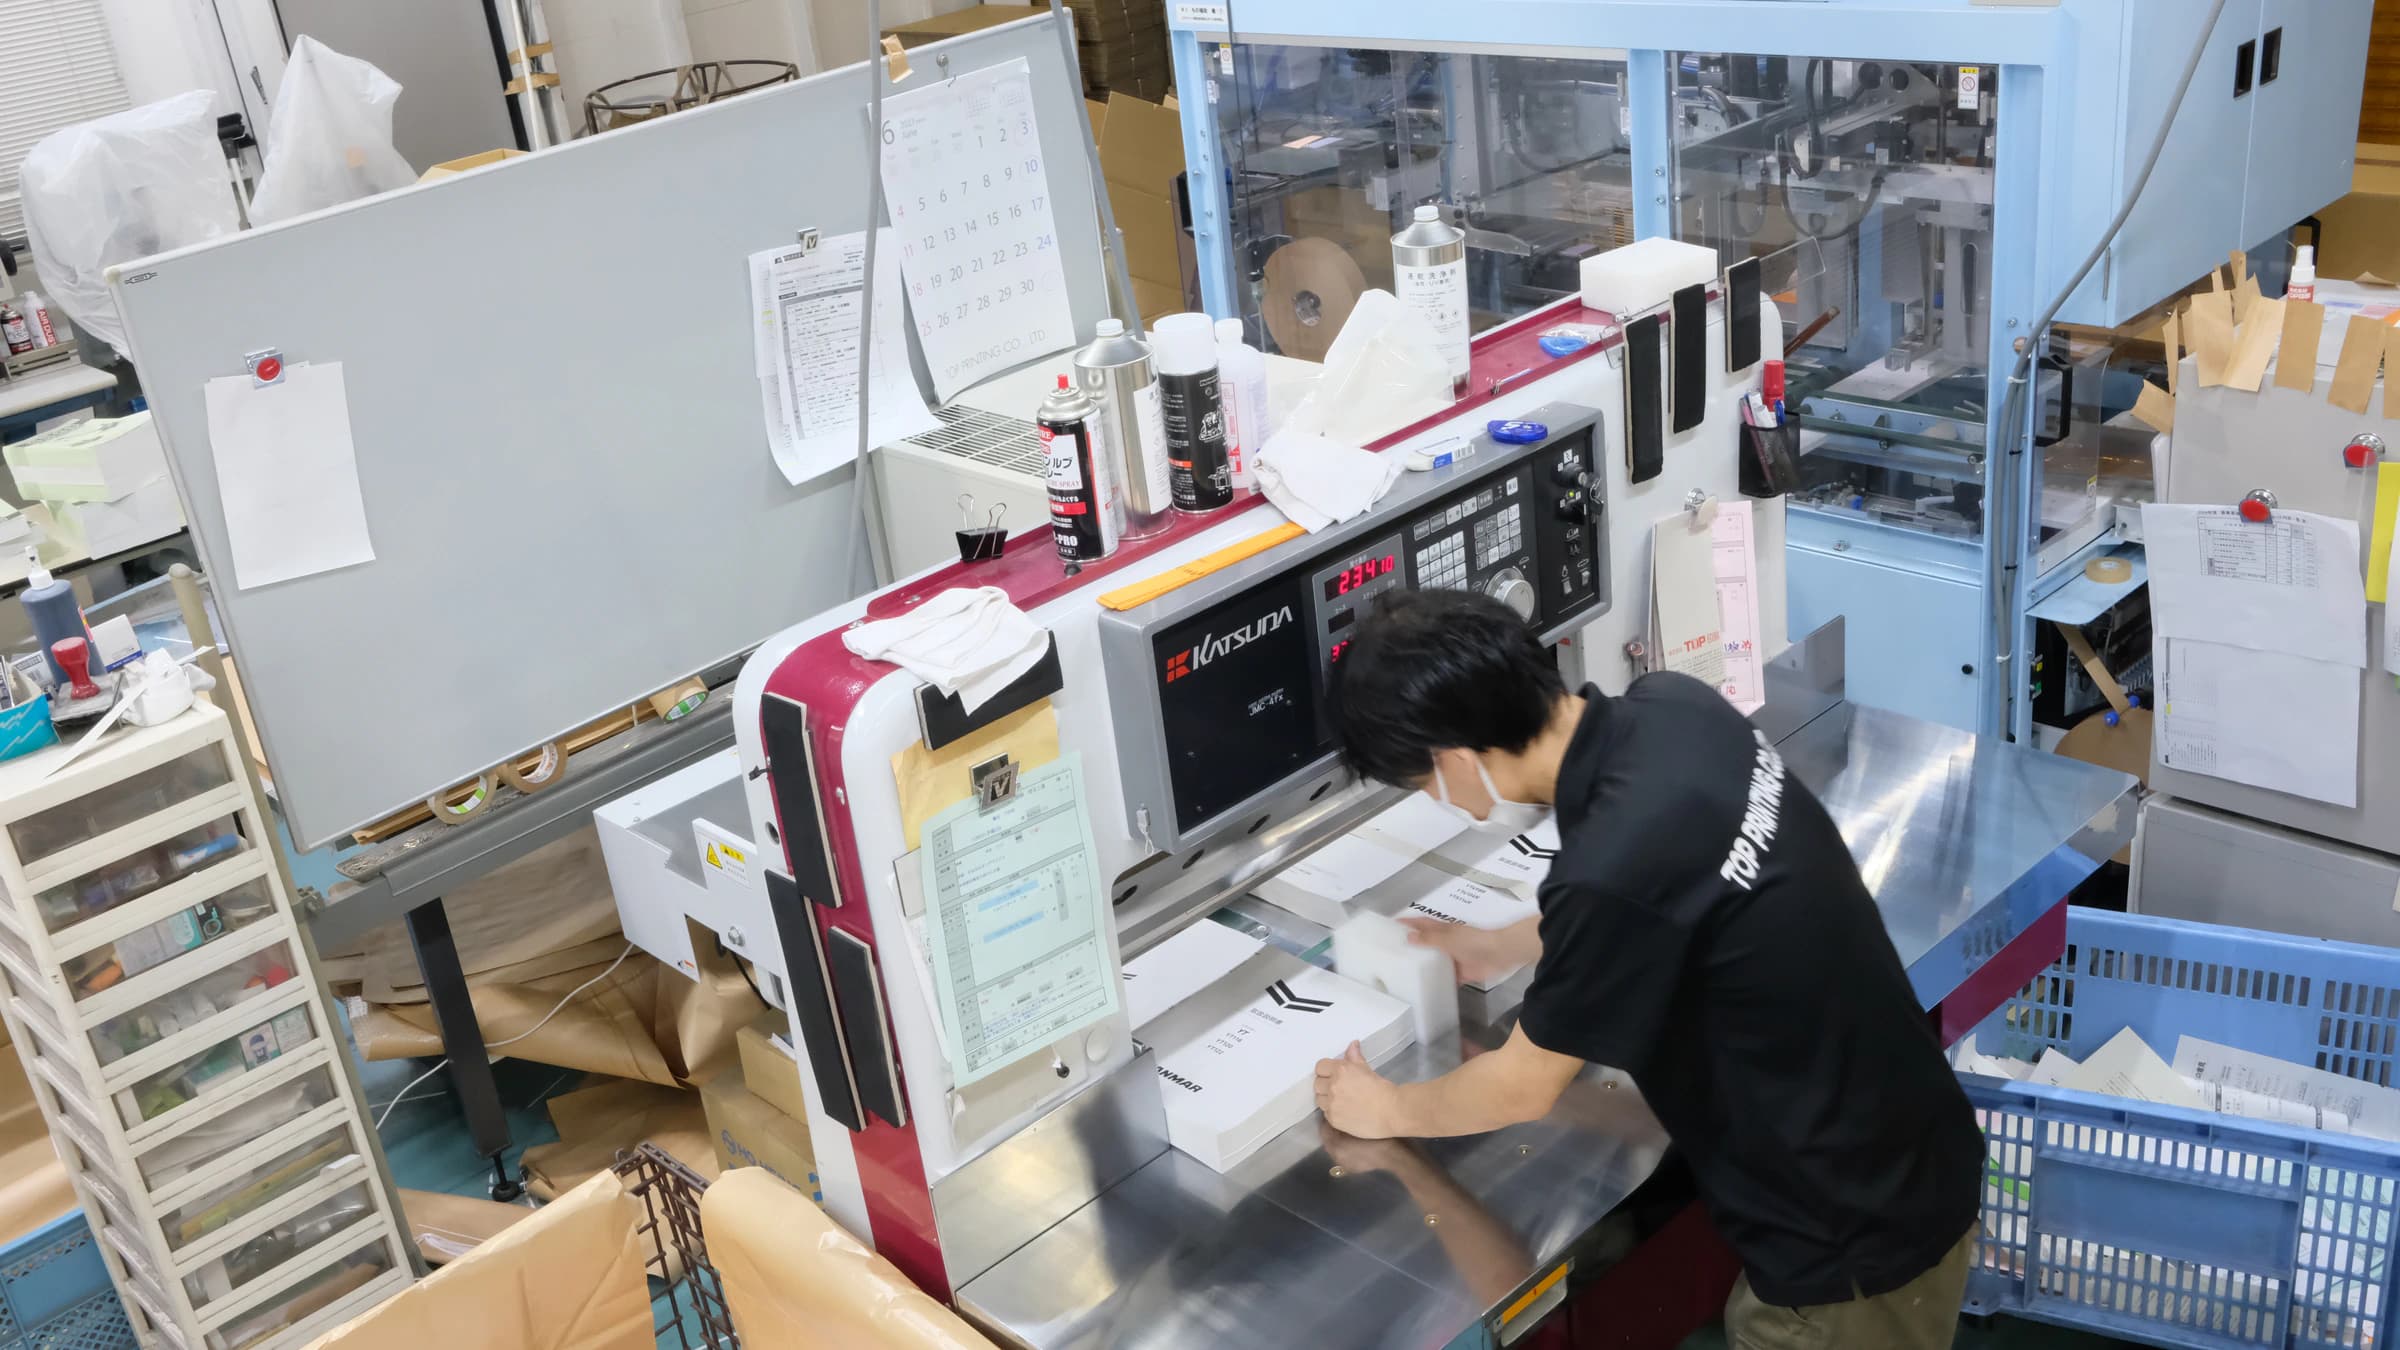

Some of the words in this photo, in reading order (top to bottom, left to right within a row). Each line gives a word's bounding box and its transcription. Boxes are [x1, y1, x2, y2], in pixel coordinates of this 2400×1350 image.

[882, 120, 895, 145] 6
[978, 135, 984, 149] 1
[1000, 128, 1008, 143] 2
[1021, 121, 1029, 135] 3
[897, 205, 905, 218] 4
[918, 197, 926, 211] 5
[939, 189, 948, 203] 6
[961, 181, 968, 195] 7
[983, 174, 991, 188] 8
[1005, 167, 1013, 181] 9
[1025, 159, 1039, 174] 10
[904, 244, 914, 257] 11
[922, 235, 936, 250] 12
[944, 228, 957, 243] 13
[964, 220, 977, 235] 14
[987, 212, 1000, 227] 15
[1008, 204, 1022, 219] 16
[1031, 197, 1044, 211] 17
[912, 283, 923, 297] 18
[930, 274, 942, 289] 19
[949, 265, 963, 282] 20
[971, 257, 984, 273] 21
[992, 250, 1006, 265] 22
[1014, 242, 1028, 257] 23
[1036, 234, 1052, 250] 24
[921, 320, 932, 337] 25
[937, 312, 950, 328] 26
[956, 304, 969, 319] 27
[977, 295, 991, 311] 28
[999, 287, 1012, 302] 29
[1020, 279, 1035, 295] 30
[1720, 837, 1760, 890] TOP
[1741, 768, 1783, 852] PRINTING
[1156, 1065, 1203, 1093] ANMAR
